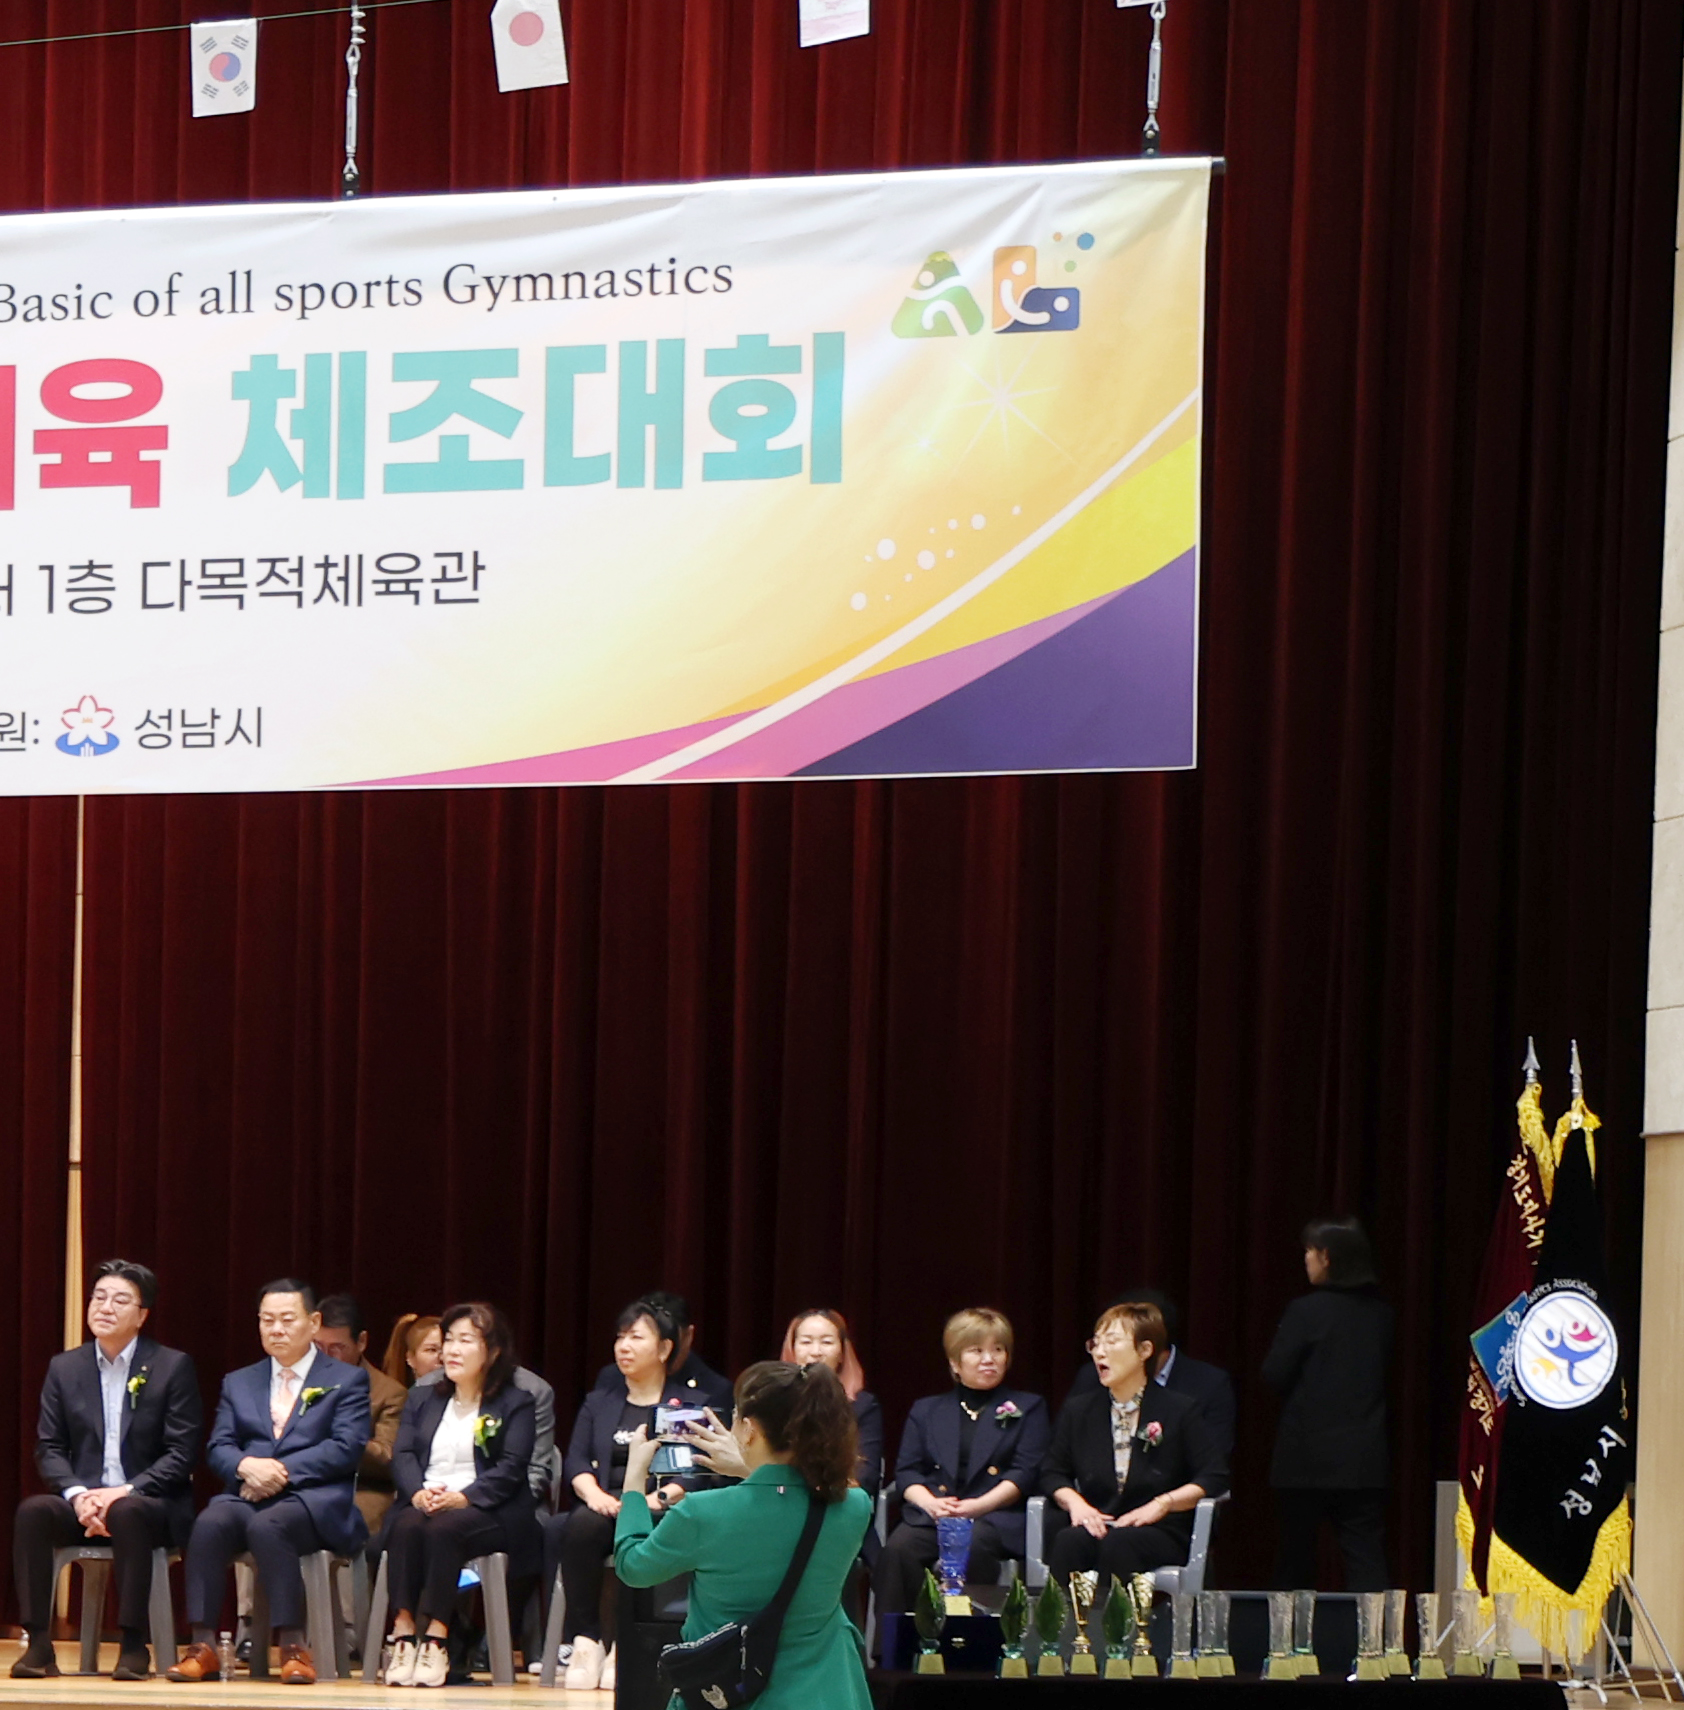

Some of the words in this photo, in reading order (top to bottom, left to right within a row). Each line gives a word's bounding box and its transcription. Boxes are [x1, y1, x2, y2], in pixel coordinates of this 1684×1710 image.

[133, 271, 182, 318] of
[200, 269, 254, 316] all
[274, 272, 423, 321] sports
[442, 256, 734, 313] Gymnastics
[226, 331, 845, 500] 체조대회
[37, 559, 117, 615] 1층
[139, 550, 486, 612] 다목적체육관
[133, 706, 264, 751] 성남시
